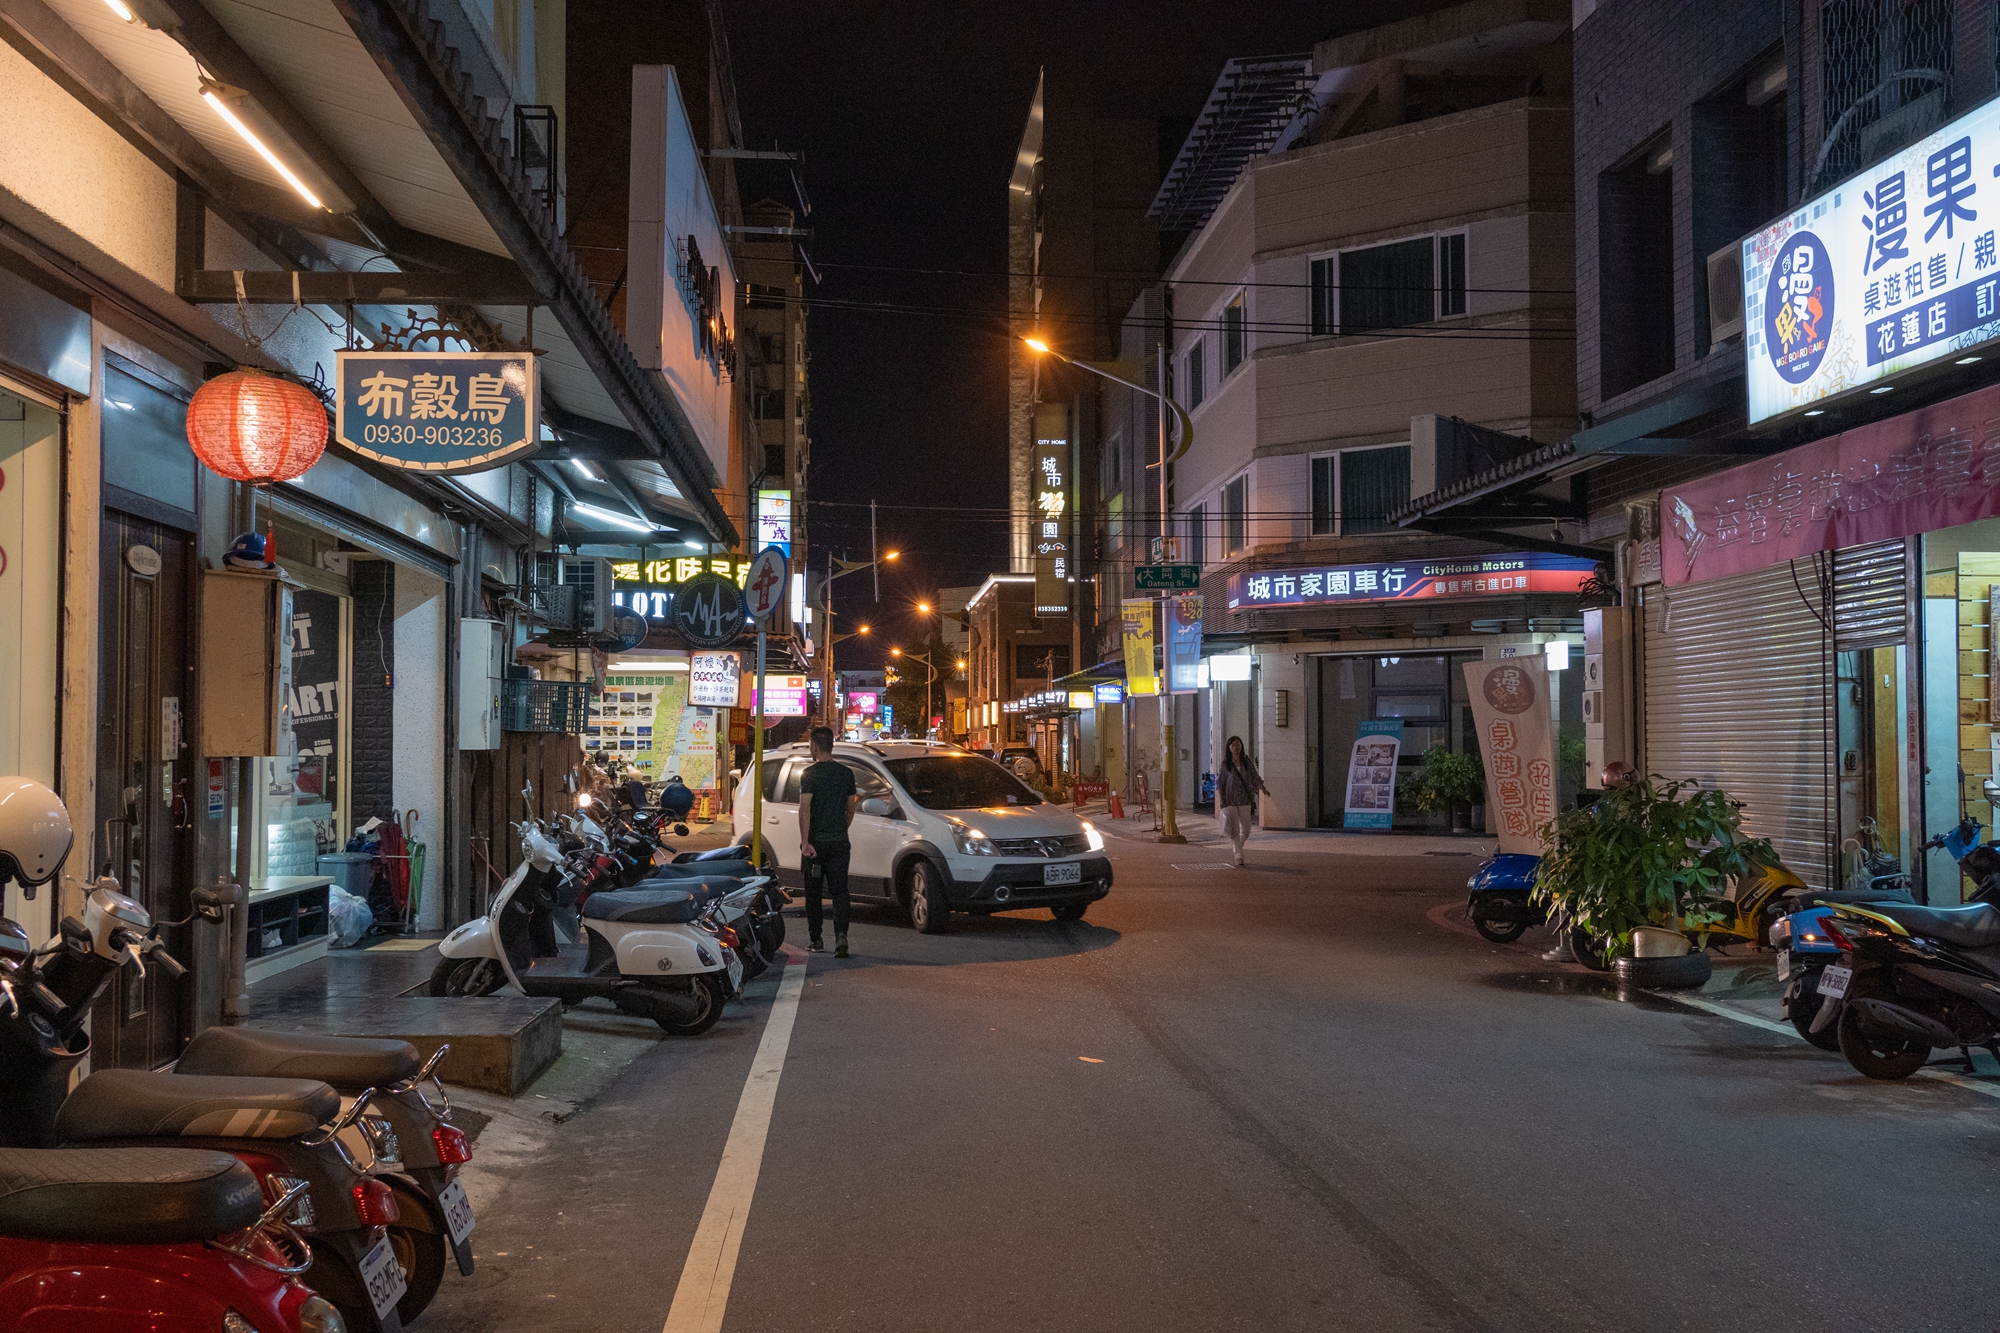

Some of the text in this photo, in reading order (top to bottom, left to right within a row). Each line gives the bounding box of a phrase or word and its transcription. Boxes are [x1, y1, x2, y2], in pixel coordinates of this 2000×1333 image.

[1862, 124, 2000, 277] 漫果
[1976, 279, 2000, 319] 訂
[1877, 301, 1947, 356] 花蓮店
[1776, 339, 1826, 368] MGZ BOARD GAME
[358, 370, 511, 425] 布穀鳥
[364, 424, 502, 447] 0930-903236
[133, 550, 157, 568] Welcome
[1055, 557, 1066, 579] 民宿
[1423, 560, 1524, 576] CityHome Motors
[1142, 567, 1192, 579] 大同街
[1147, 580, 1187, 588] Datong St.
[1247, 567, 1407, 600] 城市家園車行
[1435, 576, 1527, 594] 專售新古進口車
[293, 612, 310, 620] STUDIO
[586, 676, 674, 686] 花風景區旅遊地圖
[1055, 691, 1066, 703] 77
[314, 739, 331, 747] STUDIO
[368, 1256, 405, 1309] 952-MFG
